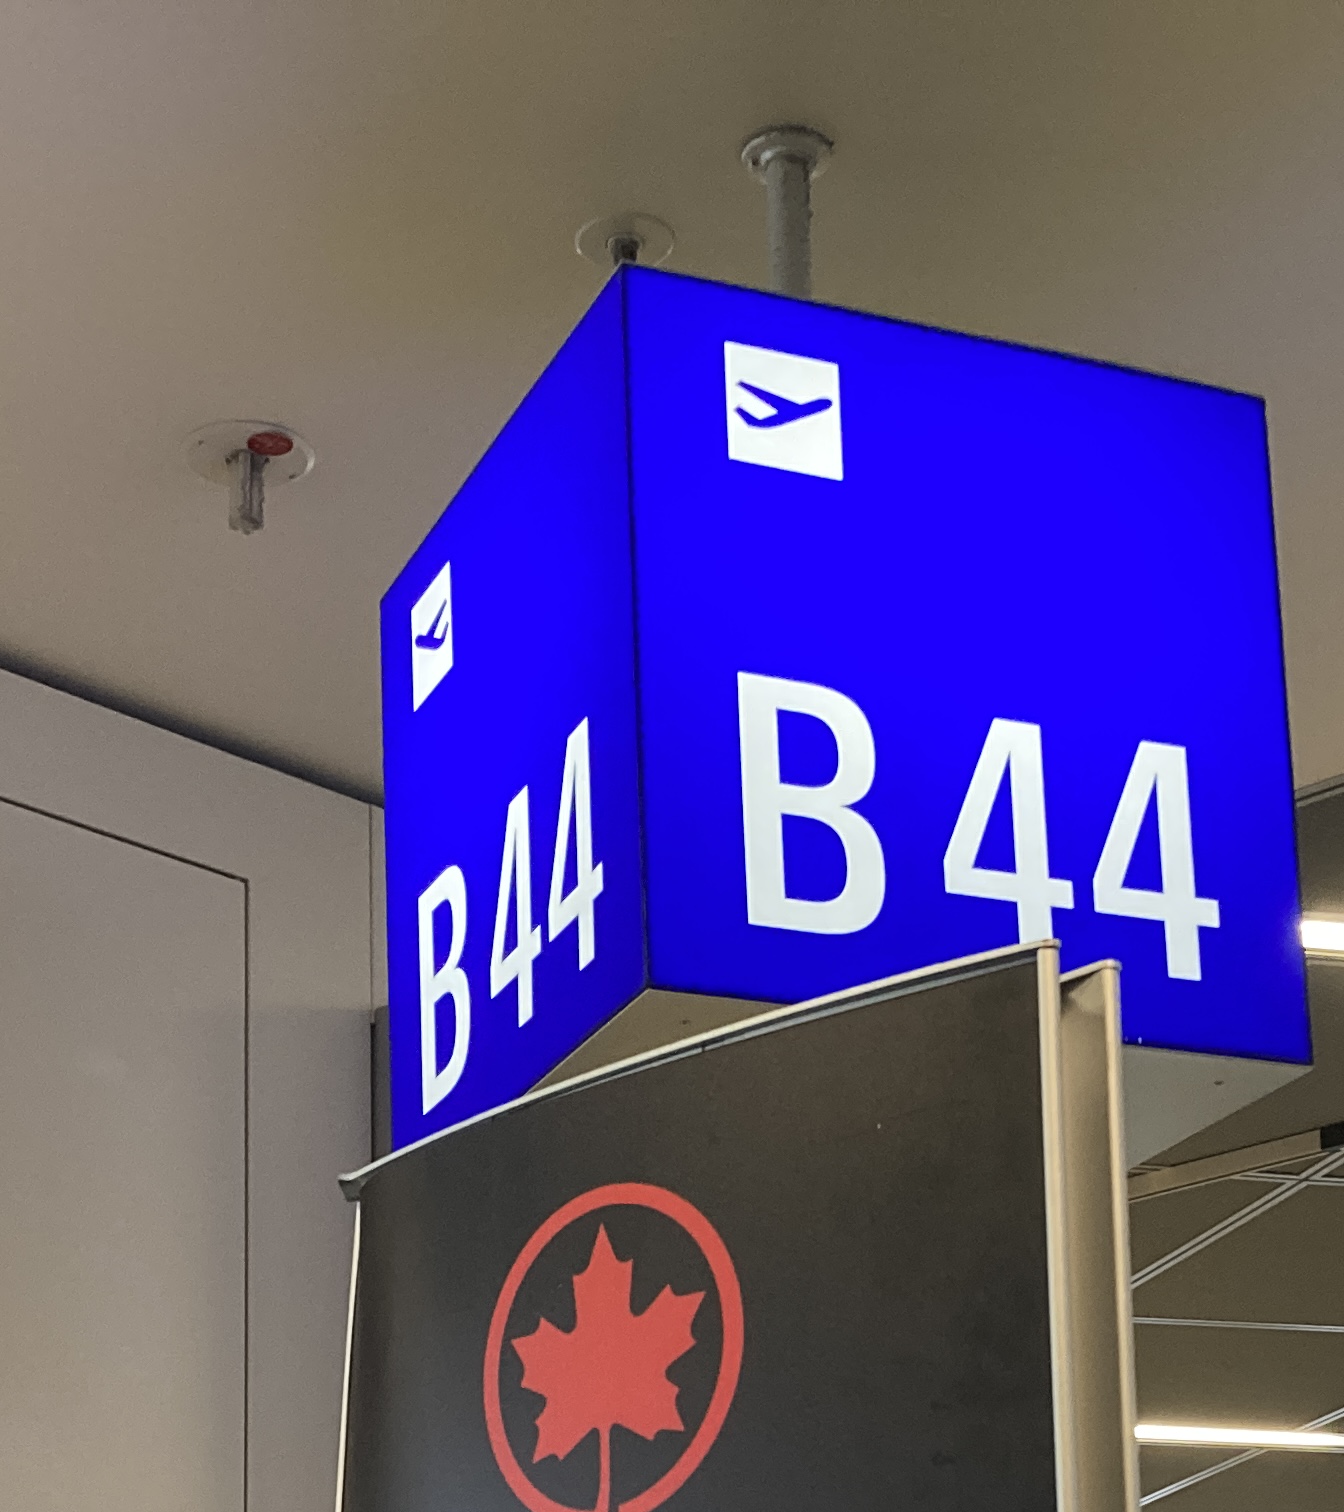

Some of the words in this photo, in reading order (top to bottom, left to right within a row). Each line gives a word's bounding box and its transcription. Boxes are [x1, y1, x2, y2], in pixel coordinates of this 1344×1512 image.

[417, 864, 471, 1116] B
[489, 716, 605, 1028] 44
[737, 670, 887, 936] B
[942, 717, 1222, 983] 44
